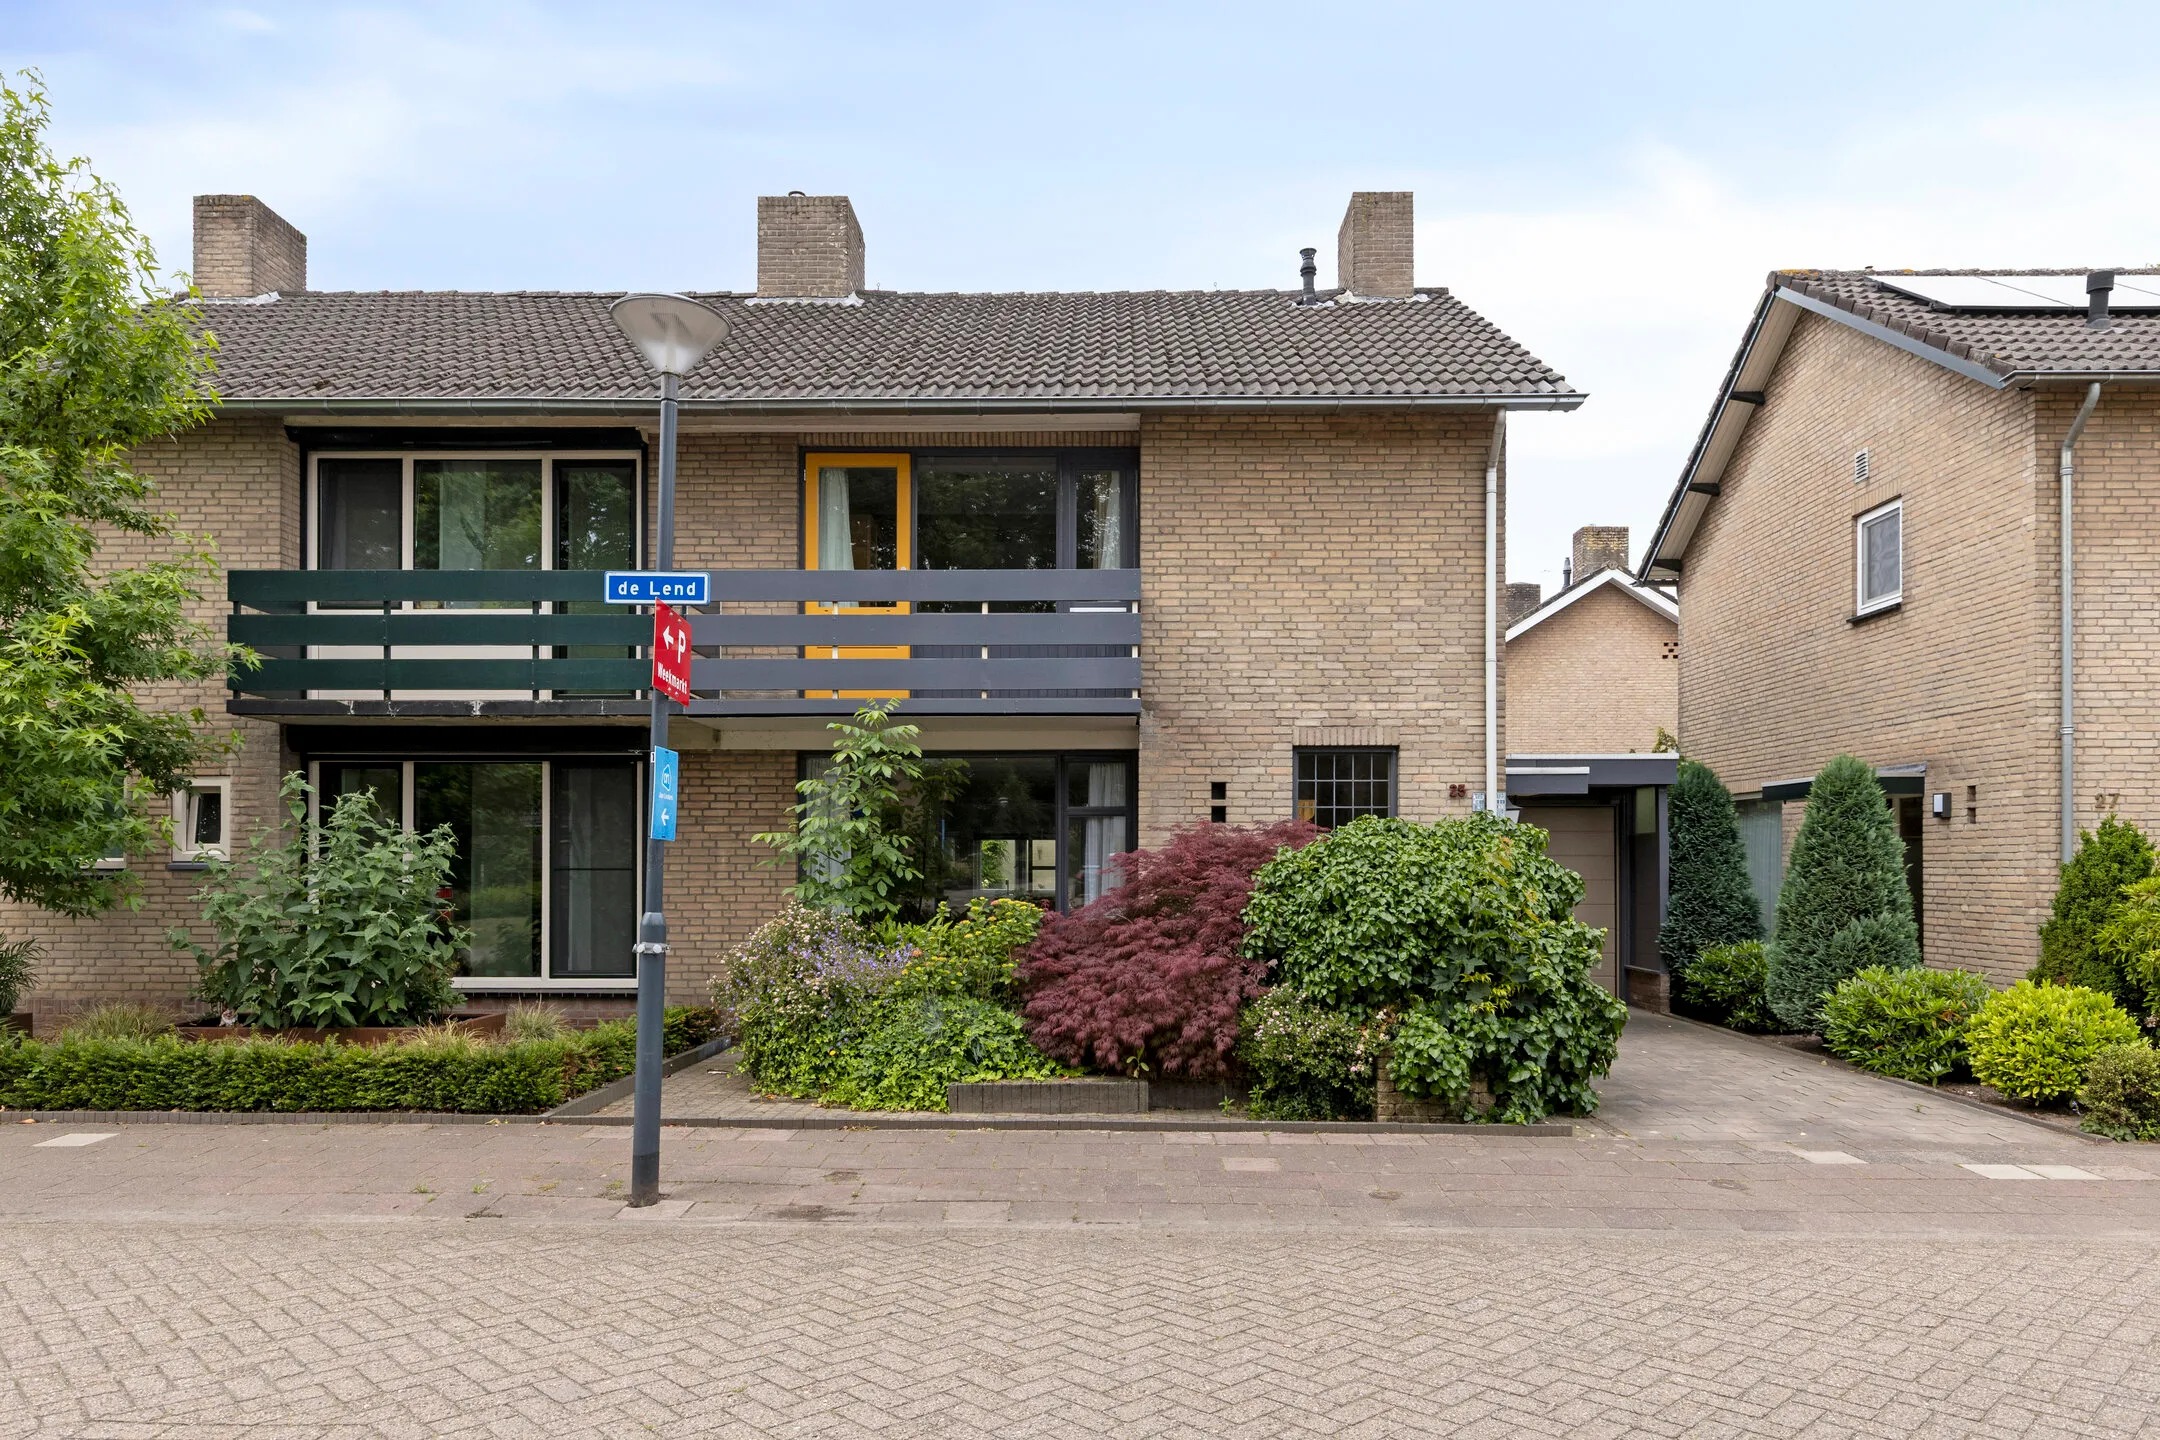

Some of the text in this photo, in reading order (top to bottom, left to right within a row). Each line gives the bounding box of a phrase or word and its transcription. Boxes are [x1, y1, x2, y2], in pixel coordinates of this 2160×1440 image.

[618, 581, 696, 596] de Lend
[678, 629, 686, 663] P
[657, 661, 688, 695] Weekmarkt
[1449, 784, 1466, 798] 25
[2094, 793, 2120, 809] 27
